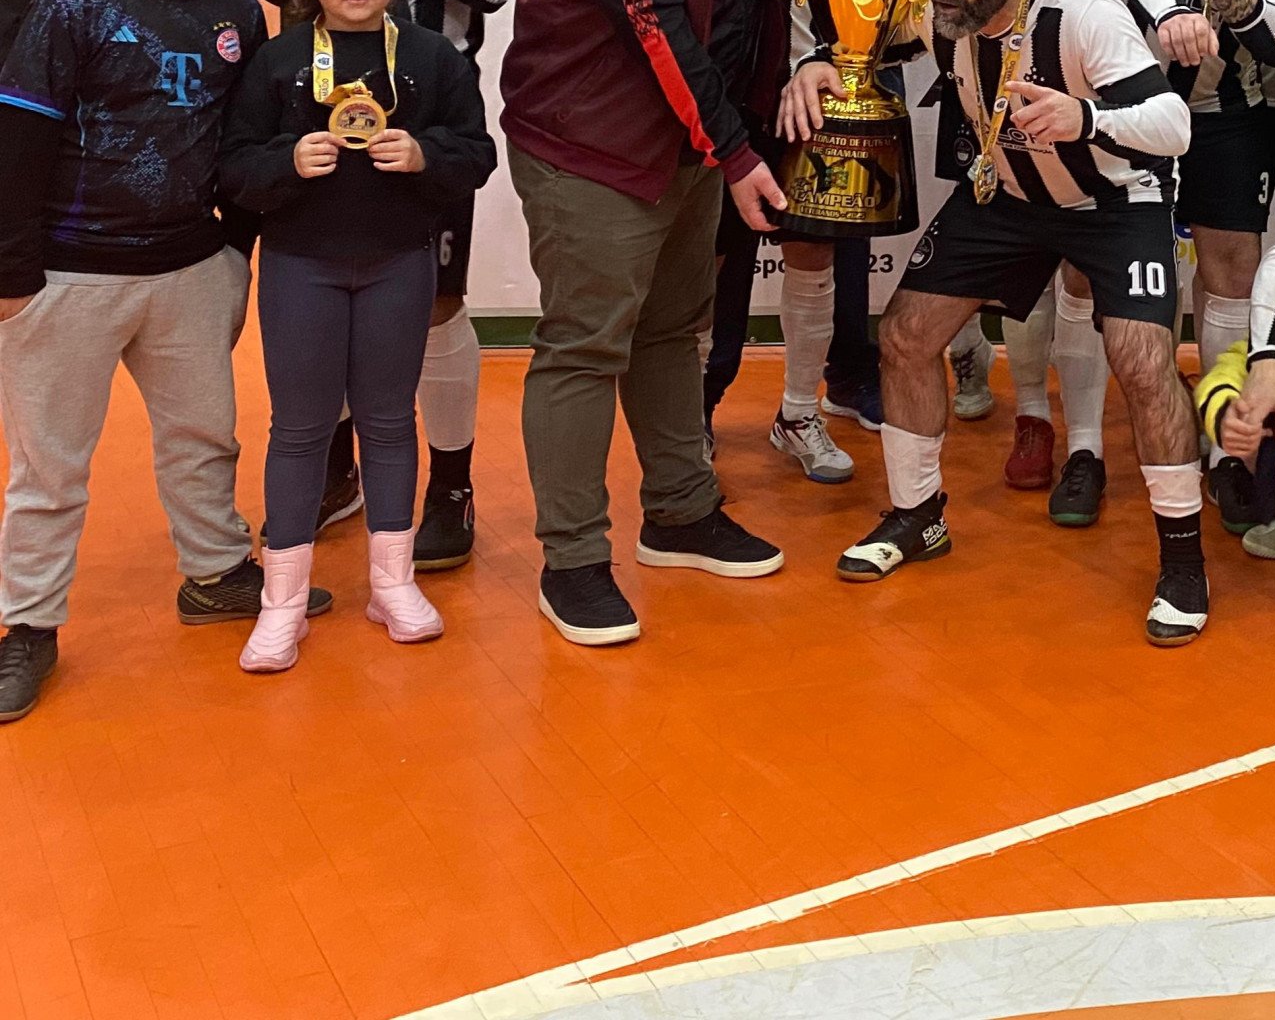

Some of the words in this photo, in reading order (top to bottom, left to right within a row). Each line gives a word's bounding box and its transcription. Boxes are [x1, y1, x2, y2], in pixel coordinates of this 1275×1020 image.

[825, 147, 869, 159] GRAMADO
[794, 186, 876, 210] CAMPEÃO
[1258, 171, 1269, 204] 3
[1127, 260, 1168, 298] 10
